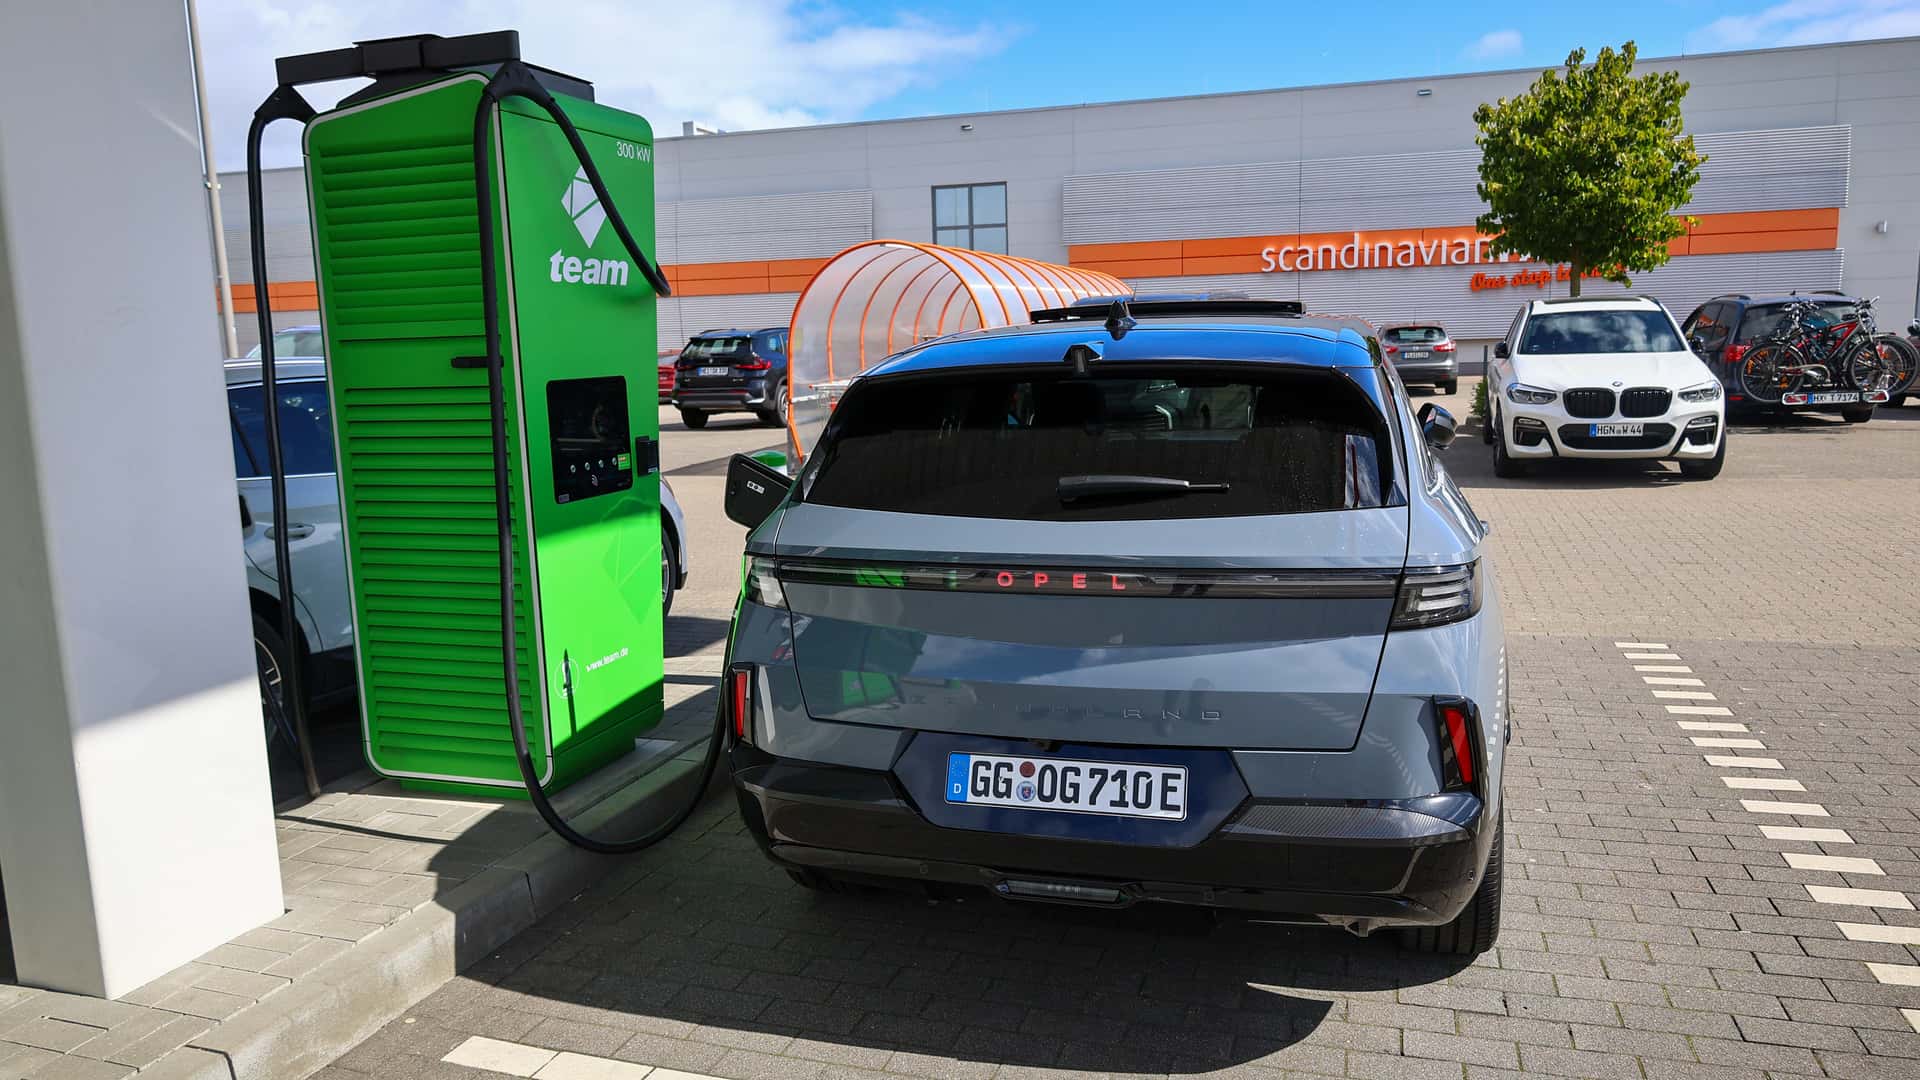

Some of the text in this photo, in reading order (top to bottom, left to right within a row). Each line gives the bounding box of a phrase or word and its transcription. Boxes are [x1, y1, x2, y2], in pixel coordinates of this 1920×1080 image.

[616, 141, 652, 163] 300 kW
[1261, 231, 1496, 273] scandinavian
[549, 249, 630, 286] team
[1469, 271, 1507, 292] One
[1510, 267, 1552, 289] stop
[1597, 424, 1616, 435] HGN
[1630, 424, 1642, 434] 44
[996, 571, 1127, 591] OPEL
[953, 783, 962, 794] D
[970, 760, 1014, 799] GG
